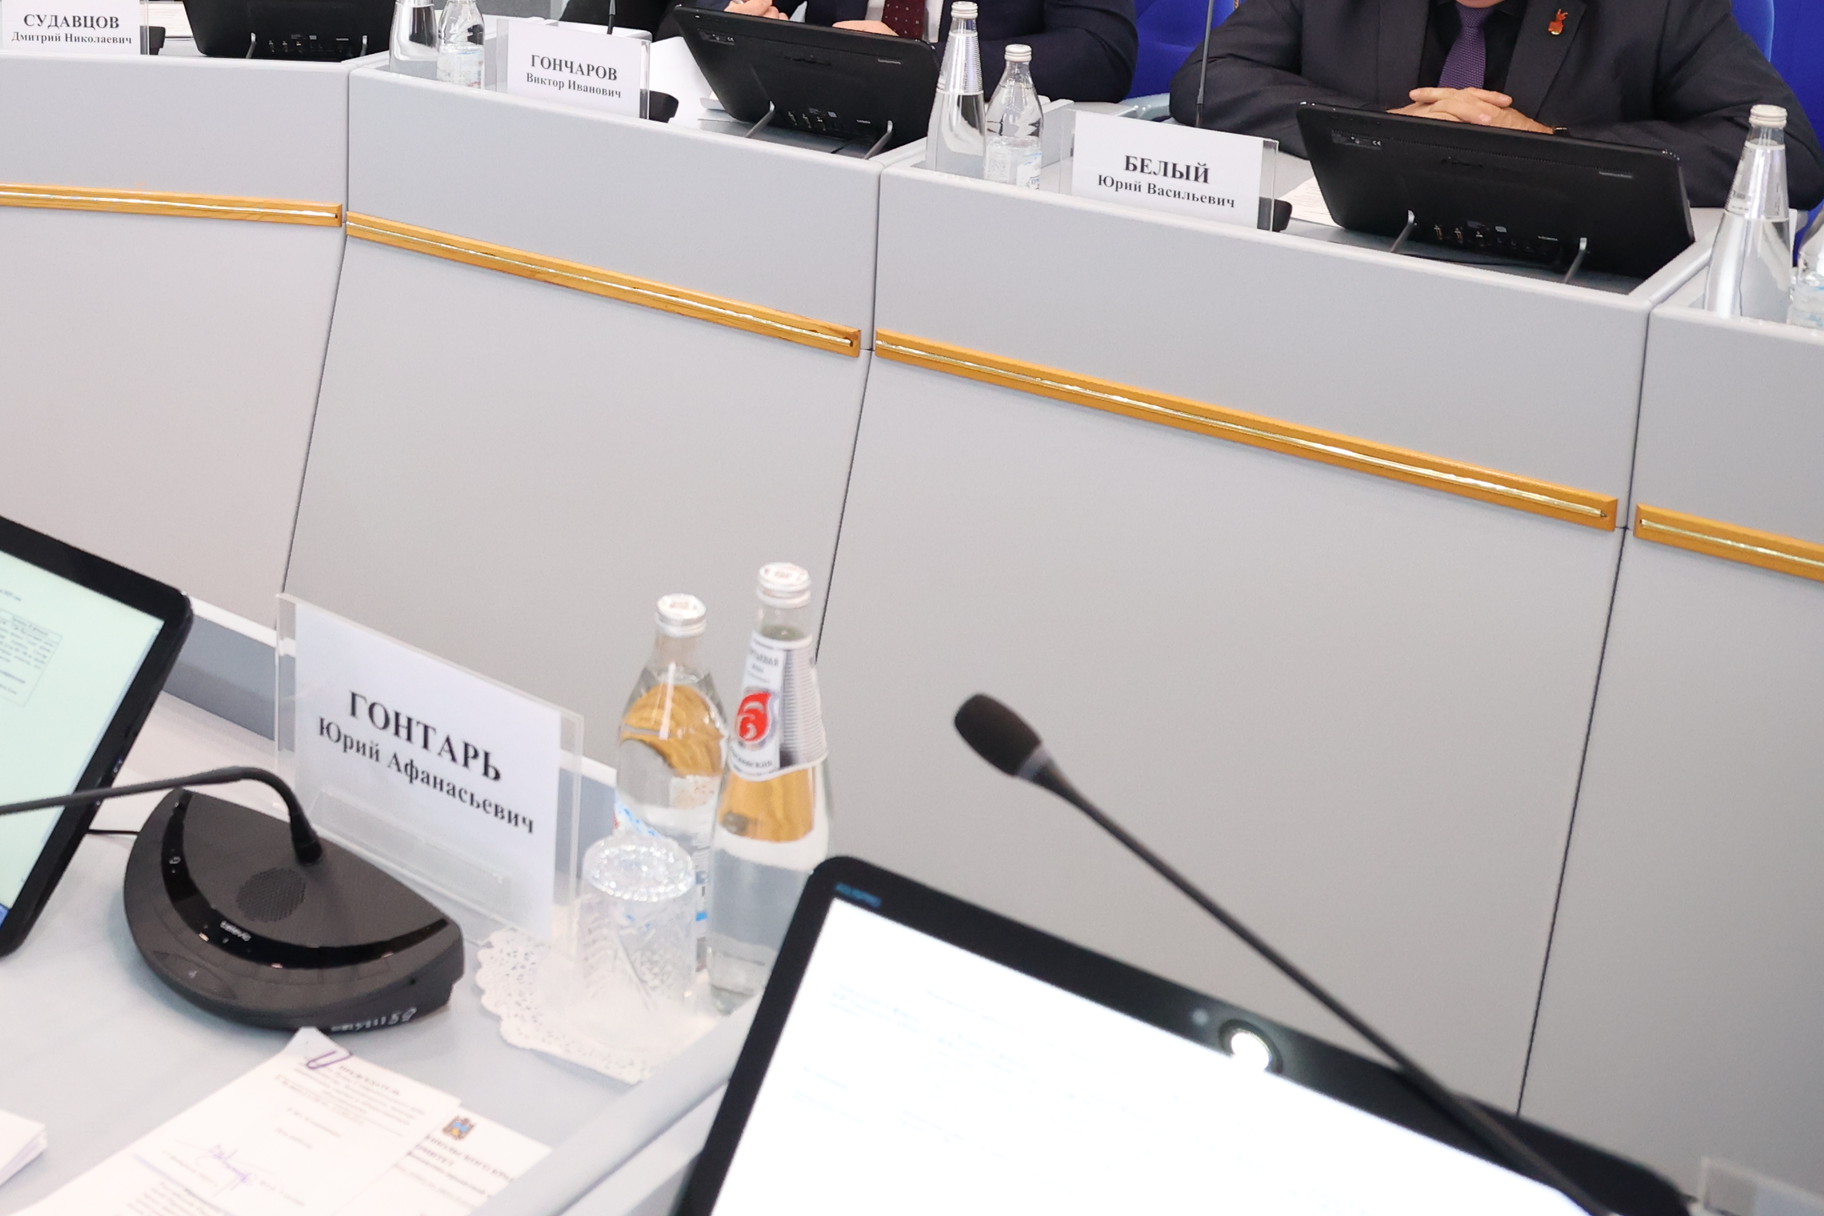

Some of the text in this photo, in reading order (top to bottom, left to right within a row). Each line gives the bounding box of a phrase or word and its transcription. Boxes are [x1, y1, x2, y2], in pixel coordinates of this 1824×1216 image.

[23, 13, 120, 30] СУДАВЦОВ
[11, 31, 132, 44] Дмитрий Николаевич
[531, 54, 618, 81] ГОНЧАРОВ
[526, 72, 622, 99] Виктор Иванович
[1123, 155, 1211, 184] БЕЛЫЙ
[1097, 174, 1236, 209] Юрий Васильевич
[348, 690, 502, 783] ГОНТАРЬ
[319, 715, 535, 835] Юрий Афанасьевич
